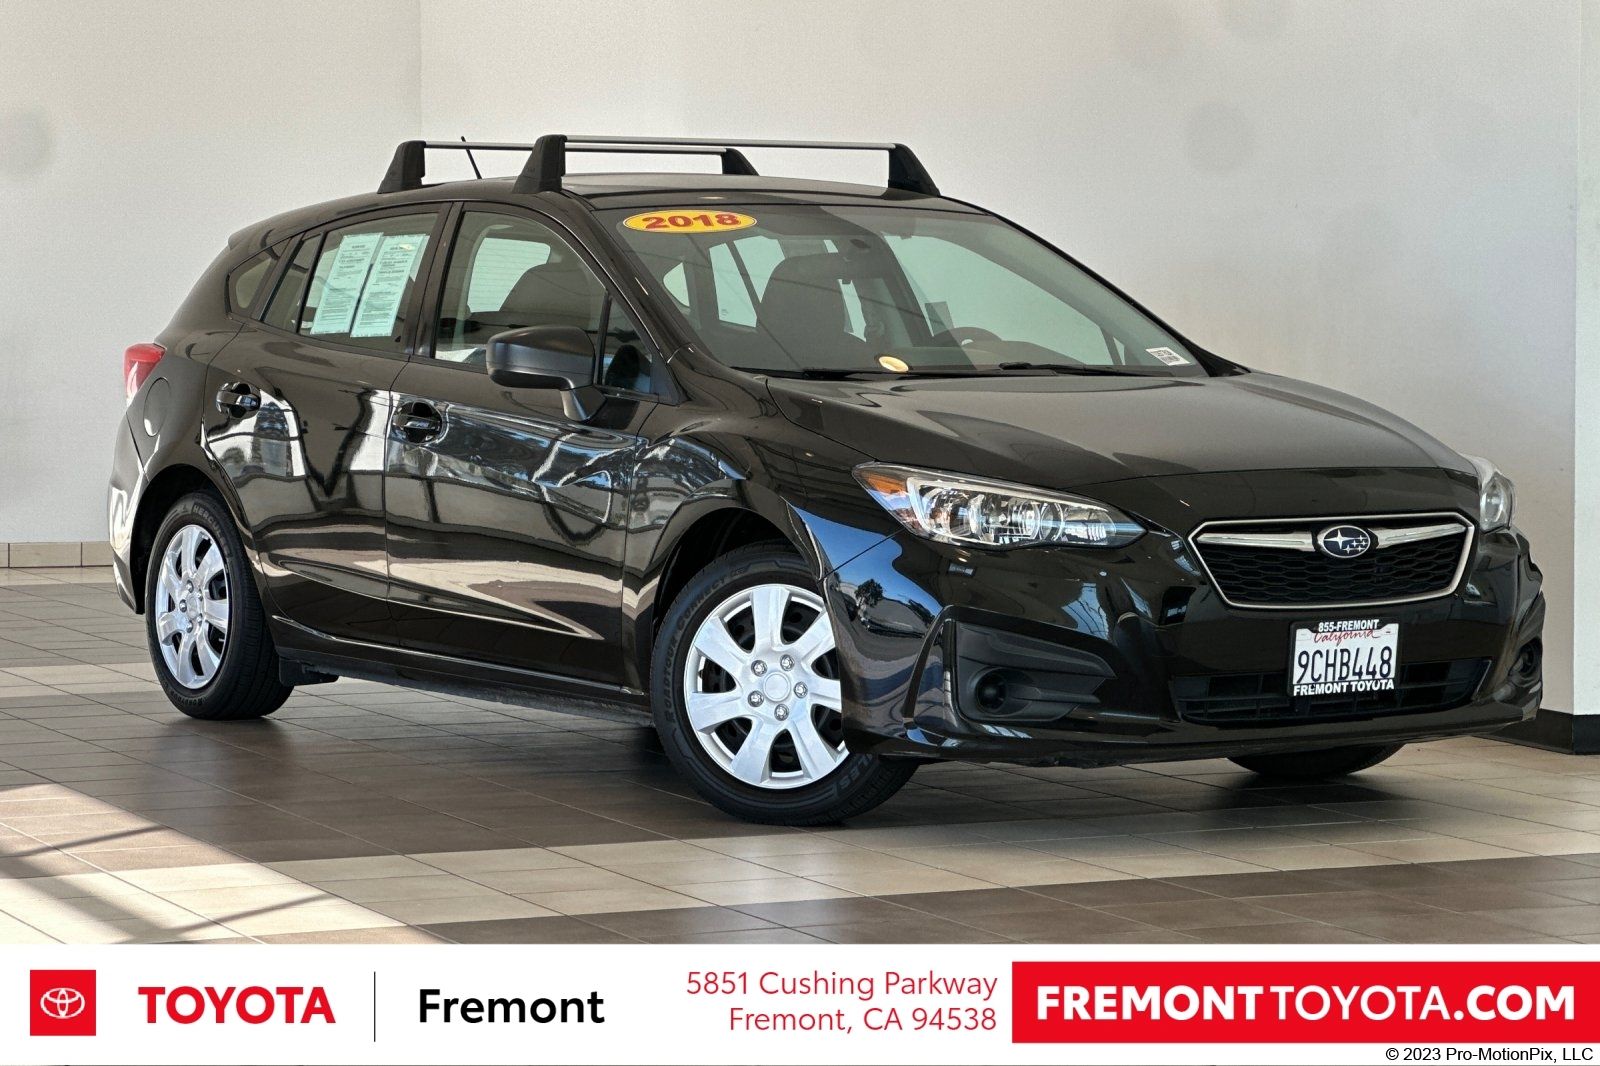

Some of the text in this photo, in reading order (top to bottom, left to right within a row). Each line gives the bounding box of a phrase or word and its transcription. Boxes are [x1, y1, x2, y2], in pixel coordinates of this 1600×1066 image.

[642, 214, 741, 230] 2018
[1318, 619, 1380, 632] 855-FREMONT
[1314, 629, 1381, 646] California
[1296, 645, 1393, 683] 9CHB448
[1293, 679, 1395, 697] FREMONT TOYOTA
